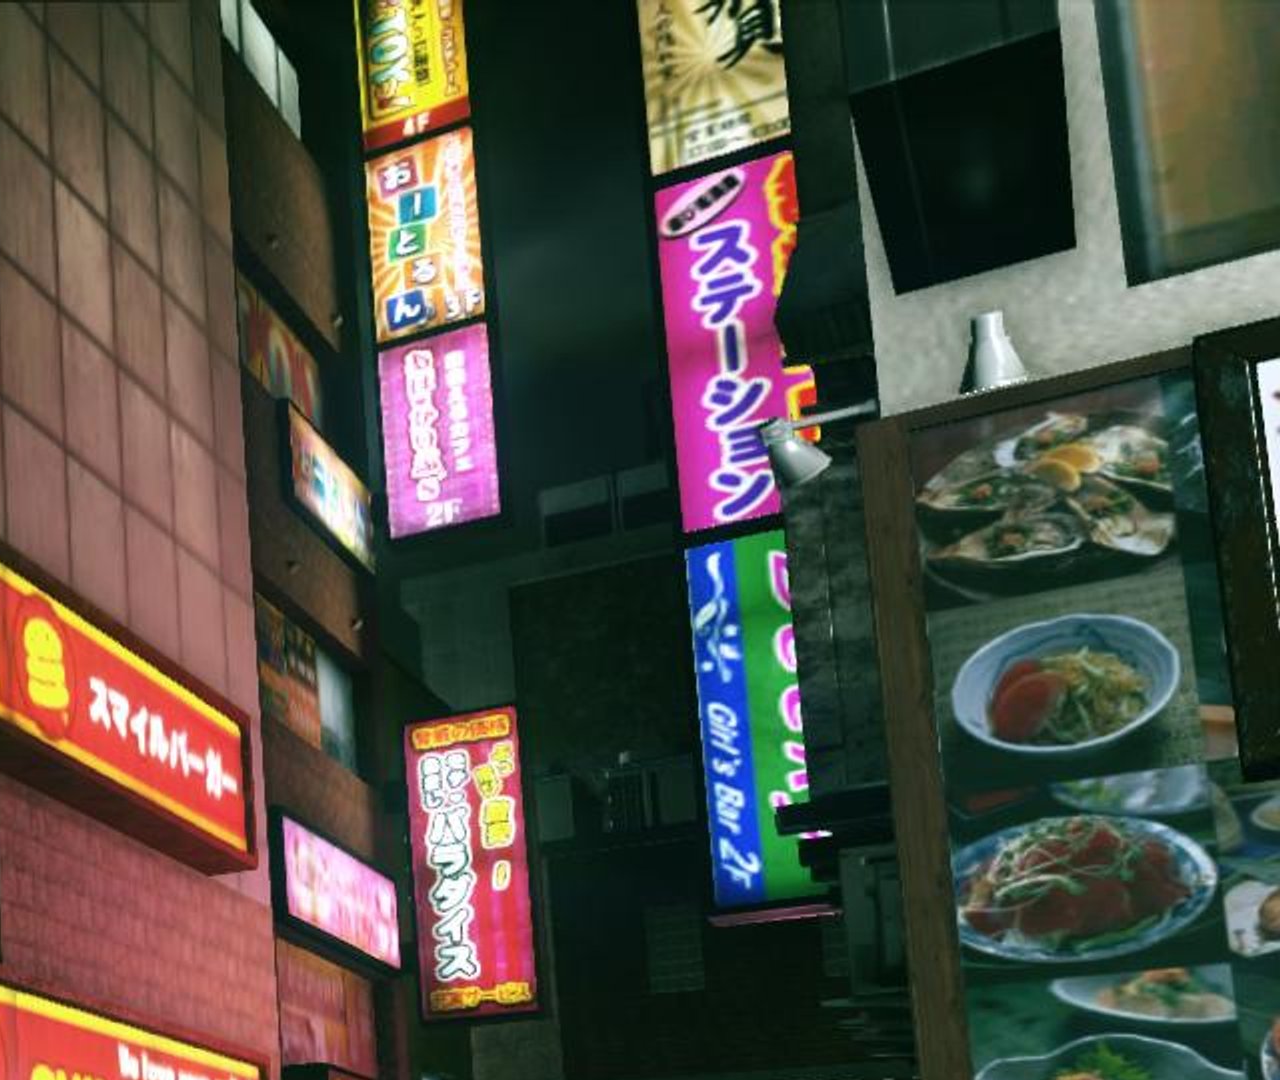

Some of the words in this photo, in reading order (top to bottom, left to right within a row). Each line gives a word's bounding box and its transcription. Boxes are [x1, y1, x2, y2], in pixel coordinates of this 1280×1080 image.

[694, 222, 774, 519] ステーション
[88, 676, 237, 801] スマイルバーガー
